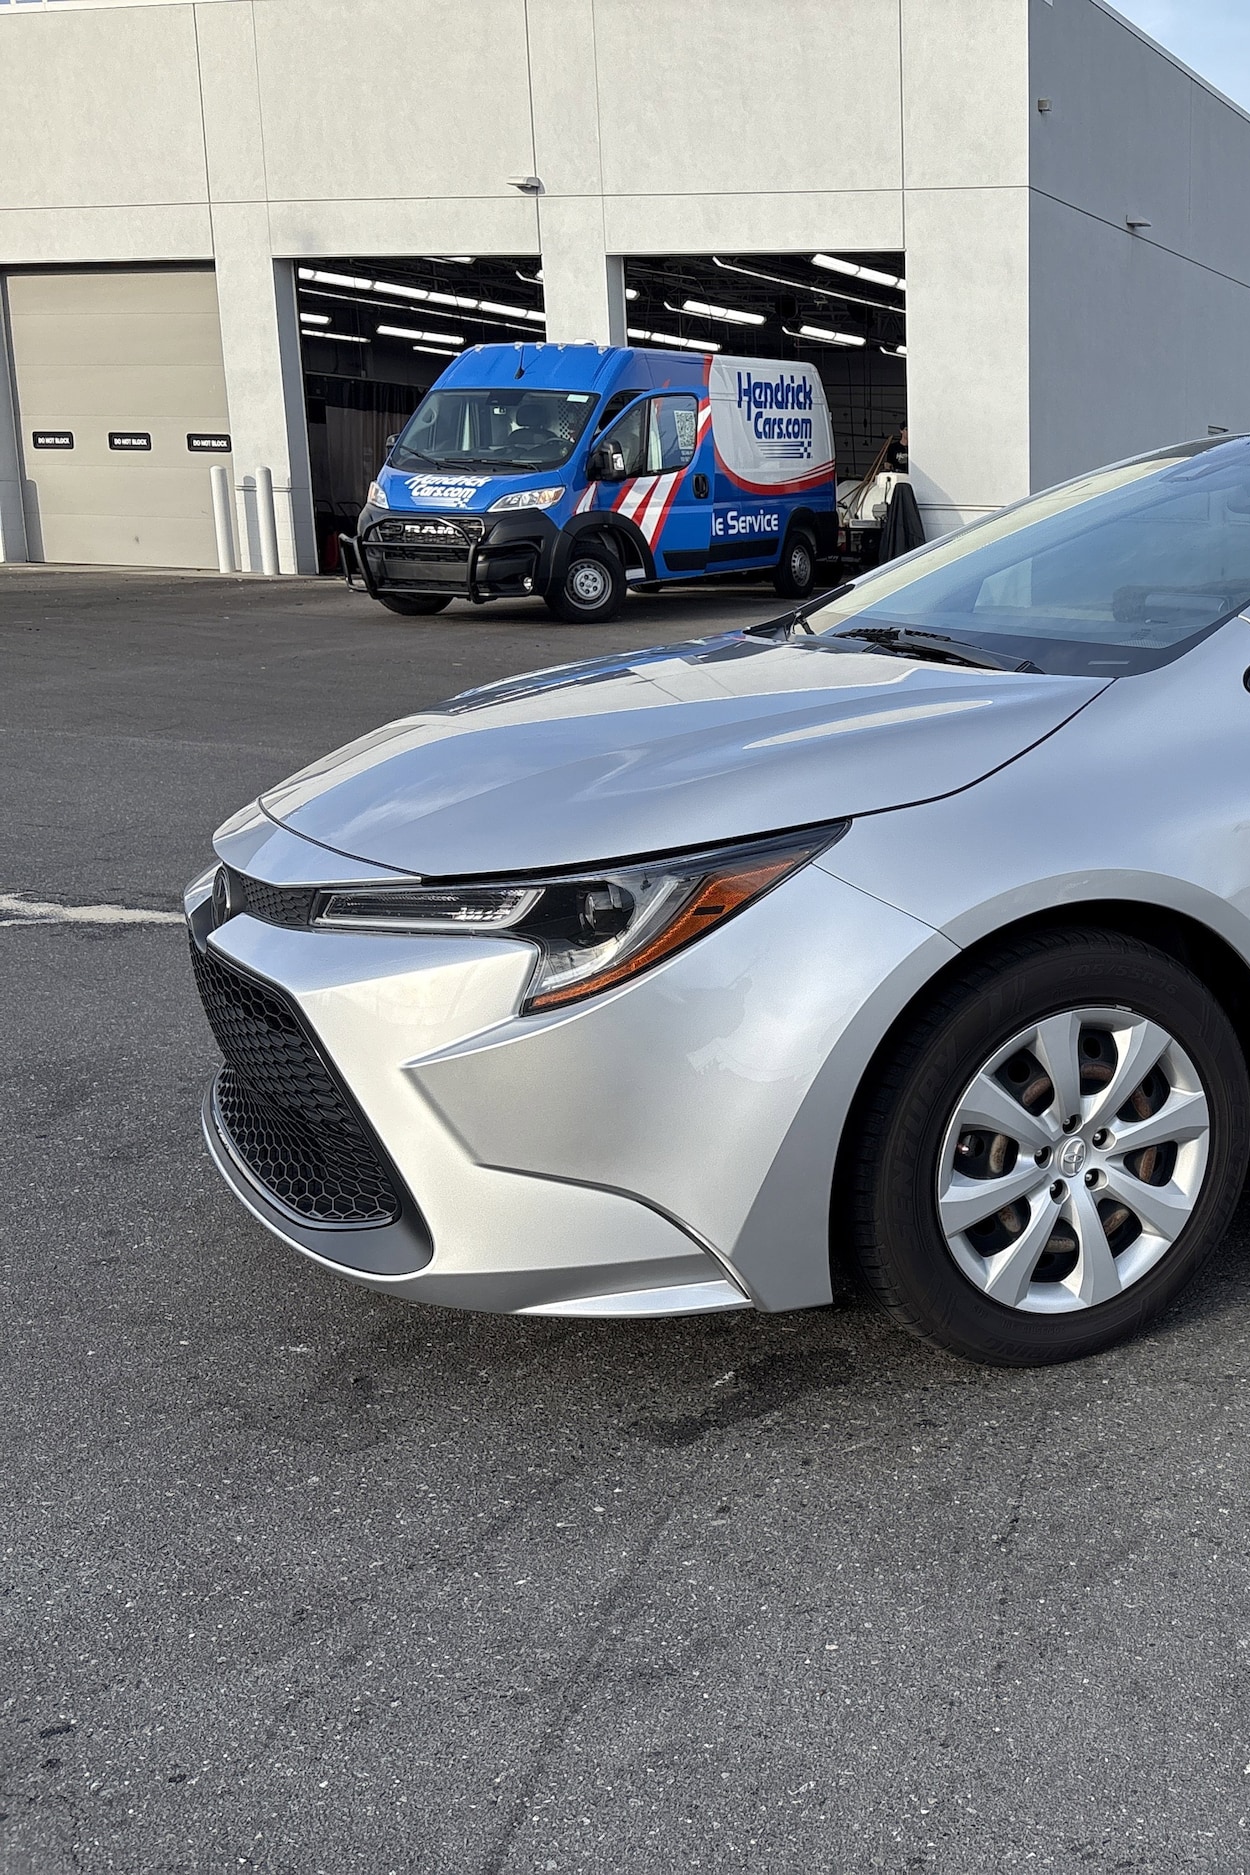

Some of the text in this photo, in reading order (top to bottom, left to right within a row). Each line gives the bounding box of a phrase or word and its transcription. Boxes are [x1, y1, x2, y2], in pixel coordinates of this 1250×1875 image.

[737, 372, 812, 421] Hendrick
[754, 411, 812, 439] Cars.com
[132, 438, 147, 446] BLOCK
[404, 474, 492, 489] Hendrick
[411, 485, 477, 497] Cars.com
[405, 525, 455, 534] RAM
[727, 509, 779, 535] Service
